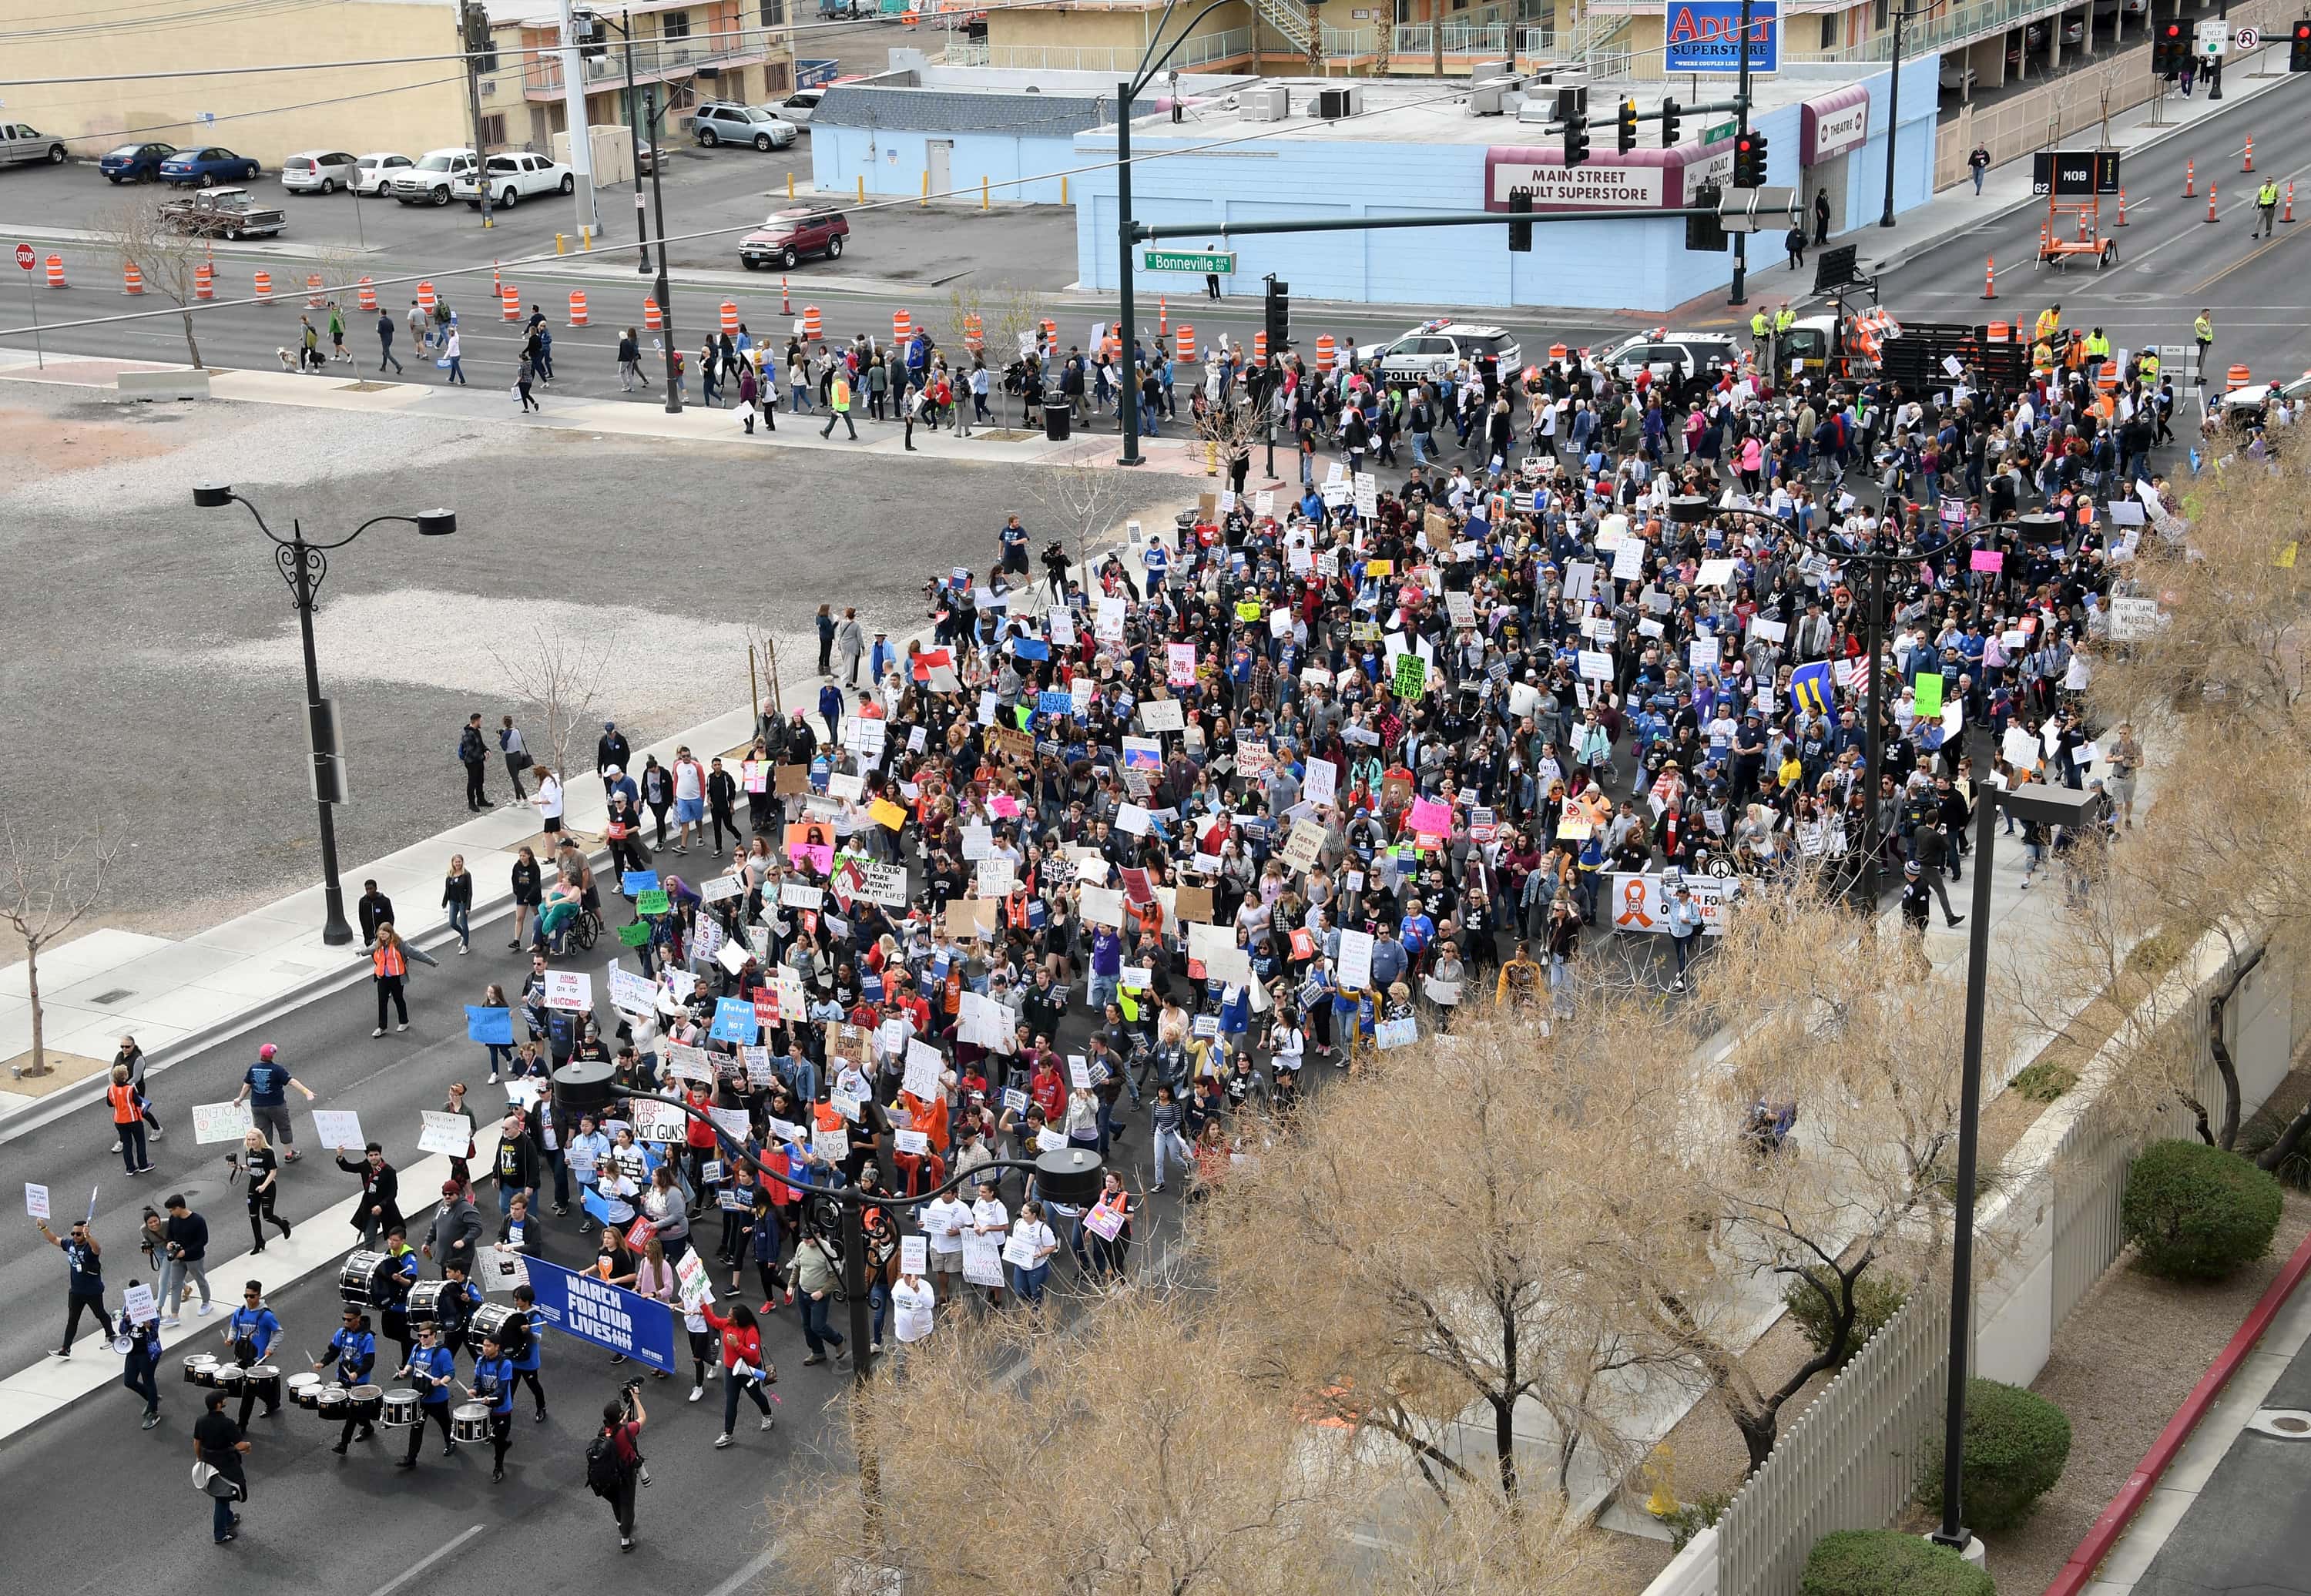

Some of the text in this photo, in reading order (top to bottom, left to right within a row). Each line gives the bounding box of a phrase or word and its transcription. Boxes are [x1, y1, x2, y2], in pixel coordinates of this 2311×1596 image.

[1672, 45, 1767, 55] SUPERSTRE
[1830, 119, 1853, 136] THEATRE
[1710, 157, 1728, 173] ADULT
[1532, 170, 1625, 183] MAIN STREET
[2063, 171, 2087, 181] MOB
[1558, 186, 1647, 200] SUPERSTORE
[2034, 183, 2049, 193] 62
[18, 252, 33, 263] STOP
[1156, 255, 1213, 270] Bonneville
[1398, 653, 1425, 663] ATTENTION
[1174, 660, 1186, 669] OUR
[1397, 659, 1424, 670] RESPONSIBLE
[1407, 676, 1423, 684] TIME
[1404, 682, 1422, 691] DITCH
[1041, 693, 1069, 705] NEVER
[1404, 689, 1420, 699] NRA
[1041, 704, 1068, 713] AGAIN
[1017, 733, 1033, 744] LIFE
[1239, 741, 1266, 753] Protect
[1309, 761, 1331, 772] PROTECT
[1314, 770, 1326, 779] US
[881, 864, 901, 875] YOUR
[979, 862, 1005, 873] BOOKS
[1705, 896, 1722, 906] FO
[550, 998, 581, 1007] HUGGING
[723, 1002, 750, 1014] Protect
[756, 1003, 778, 1012] AFRAID
[756, 1018, 780, 1028] SCHOOL
[906, 1064, 936, 1086] PEOPLE
[910, 1078, 924, 1094] DO
[636, 1100, 666, 1112] PROTECT
[636, 1112, 656, 1124] KIDS
[636, 1124, 685, 1140] NOT GUNS
[129, 1290, 146, 1299] CHANGE
[565, 1274, 622, 1308] MARCH
[132, 1309, 154, 1319] CONGRESS
[133, 1304, 150, 1313] CHANGE
[568, 1293, 633, 1331] FOR OUR
[569, 1311, 613, 1342] LIVES
